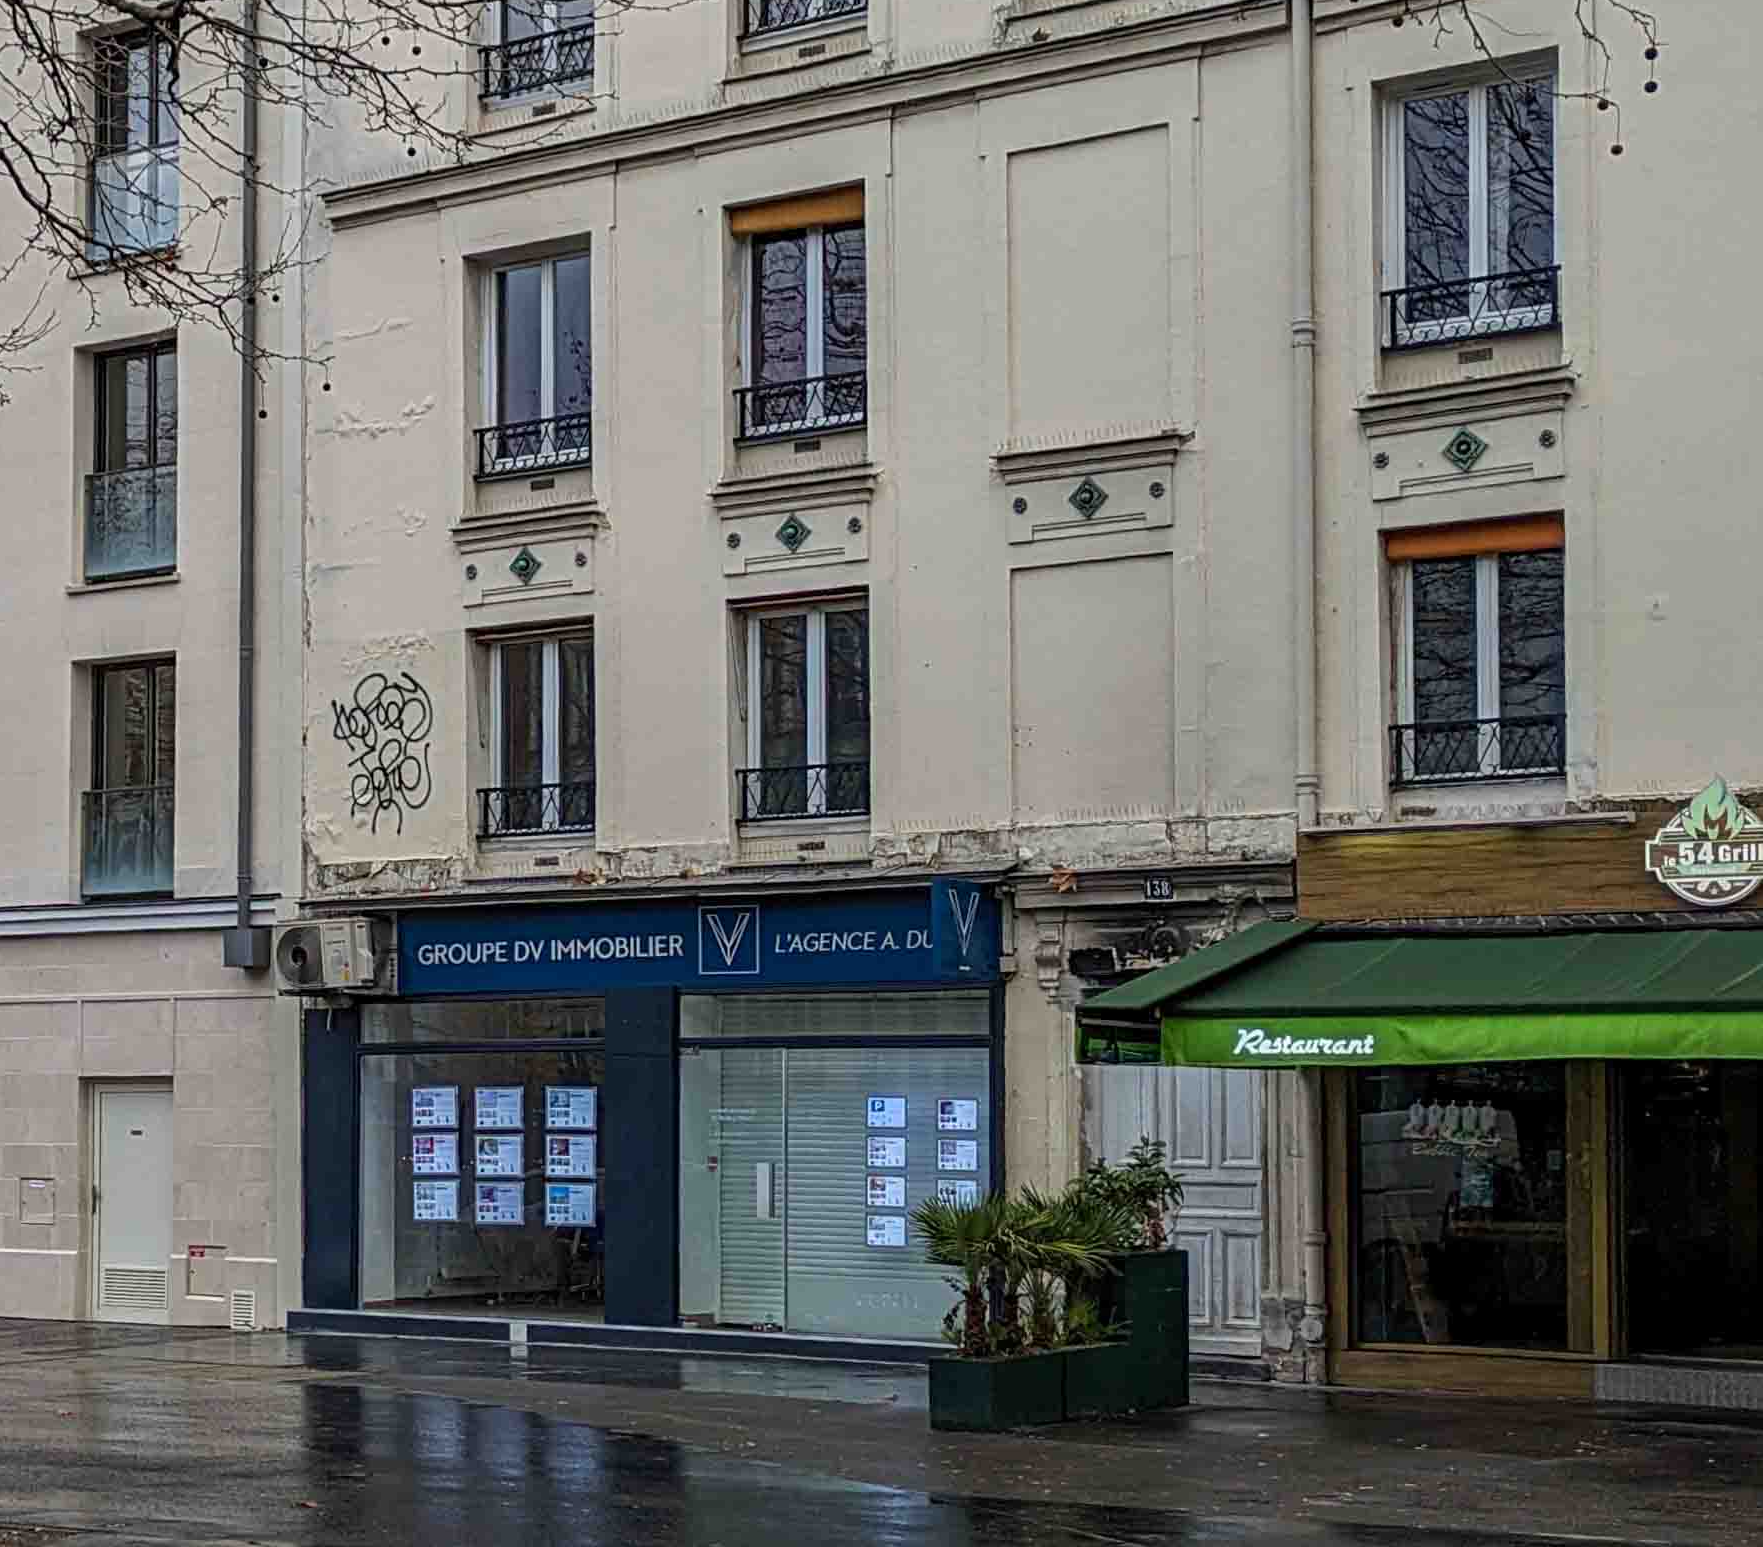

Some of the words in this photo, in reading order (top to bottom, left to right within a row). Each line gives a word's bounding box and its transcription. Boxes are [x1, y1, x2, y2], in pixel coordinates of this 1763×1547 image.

[1678, 841, 1715, 866] 54
[1718, 843, 1763, 863] Grill
[417, 941, 508, 965] GROUPE
[514, 939, 544, 962] DV
[550, 934, 684, 961] IMMOBILIER
[774, 931, 877, 953] L'AGENCE
[880, 931, 900, 951] A.
[1233, 1028, 1374, 1054] Restaurant
